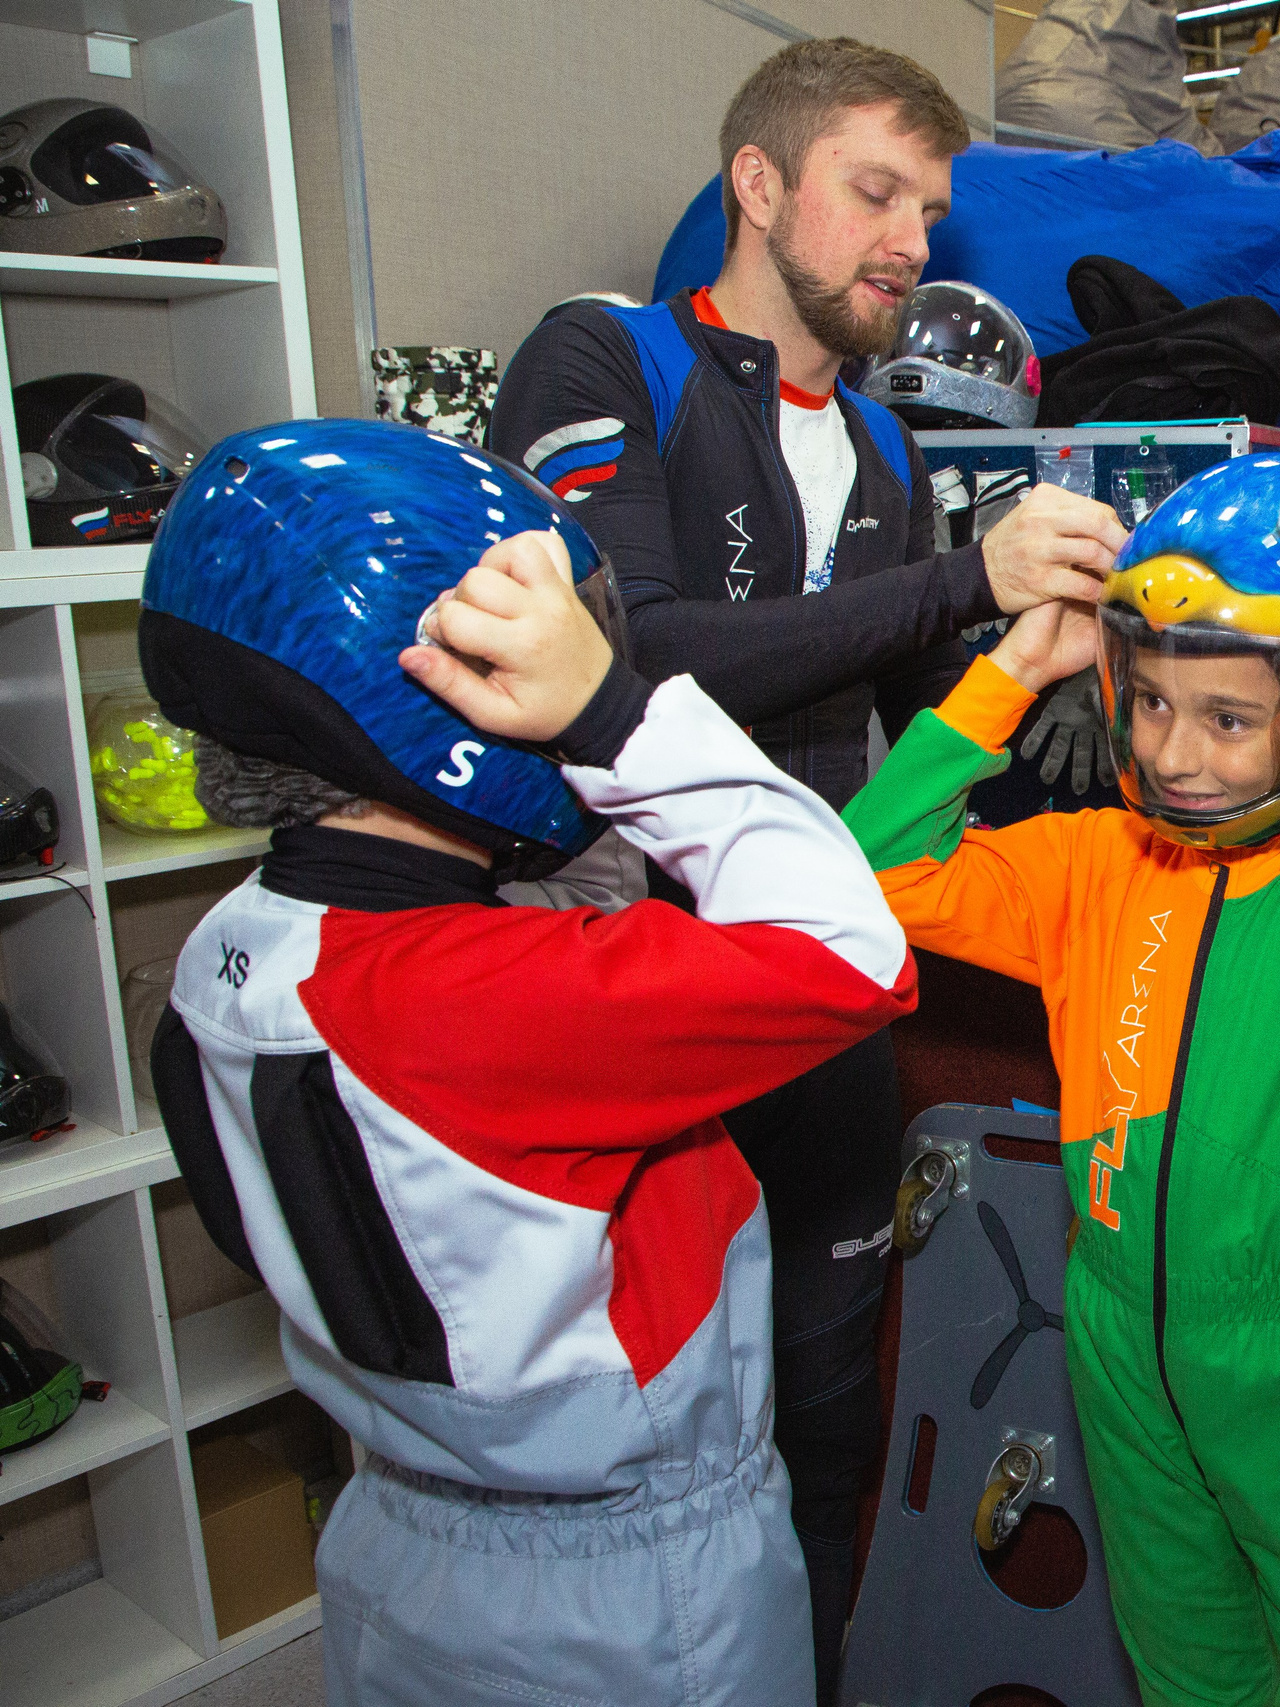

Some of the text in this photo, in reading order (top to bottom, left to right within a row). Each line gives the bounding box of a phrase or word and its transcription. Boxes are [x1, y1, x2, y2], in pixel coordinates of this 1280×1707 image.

[35, 197, 50, 214] M
[725, 504, 755, 601] ENA
[436, 740, 486, 787] S
[217, 941, 250, 990] XS
[1088, 909, 1173, 1232] FLY ARENA
